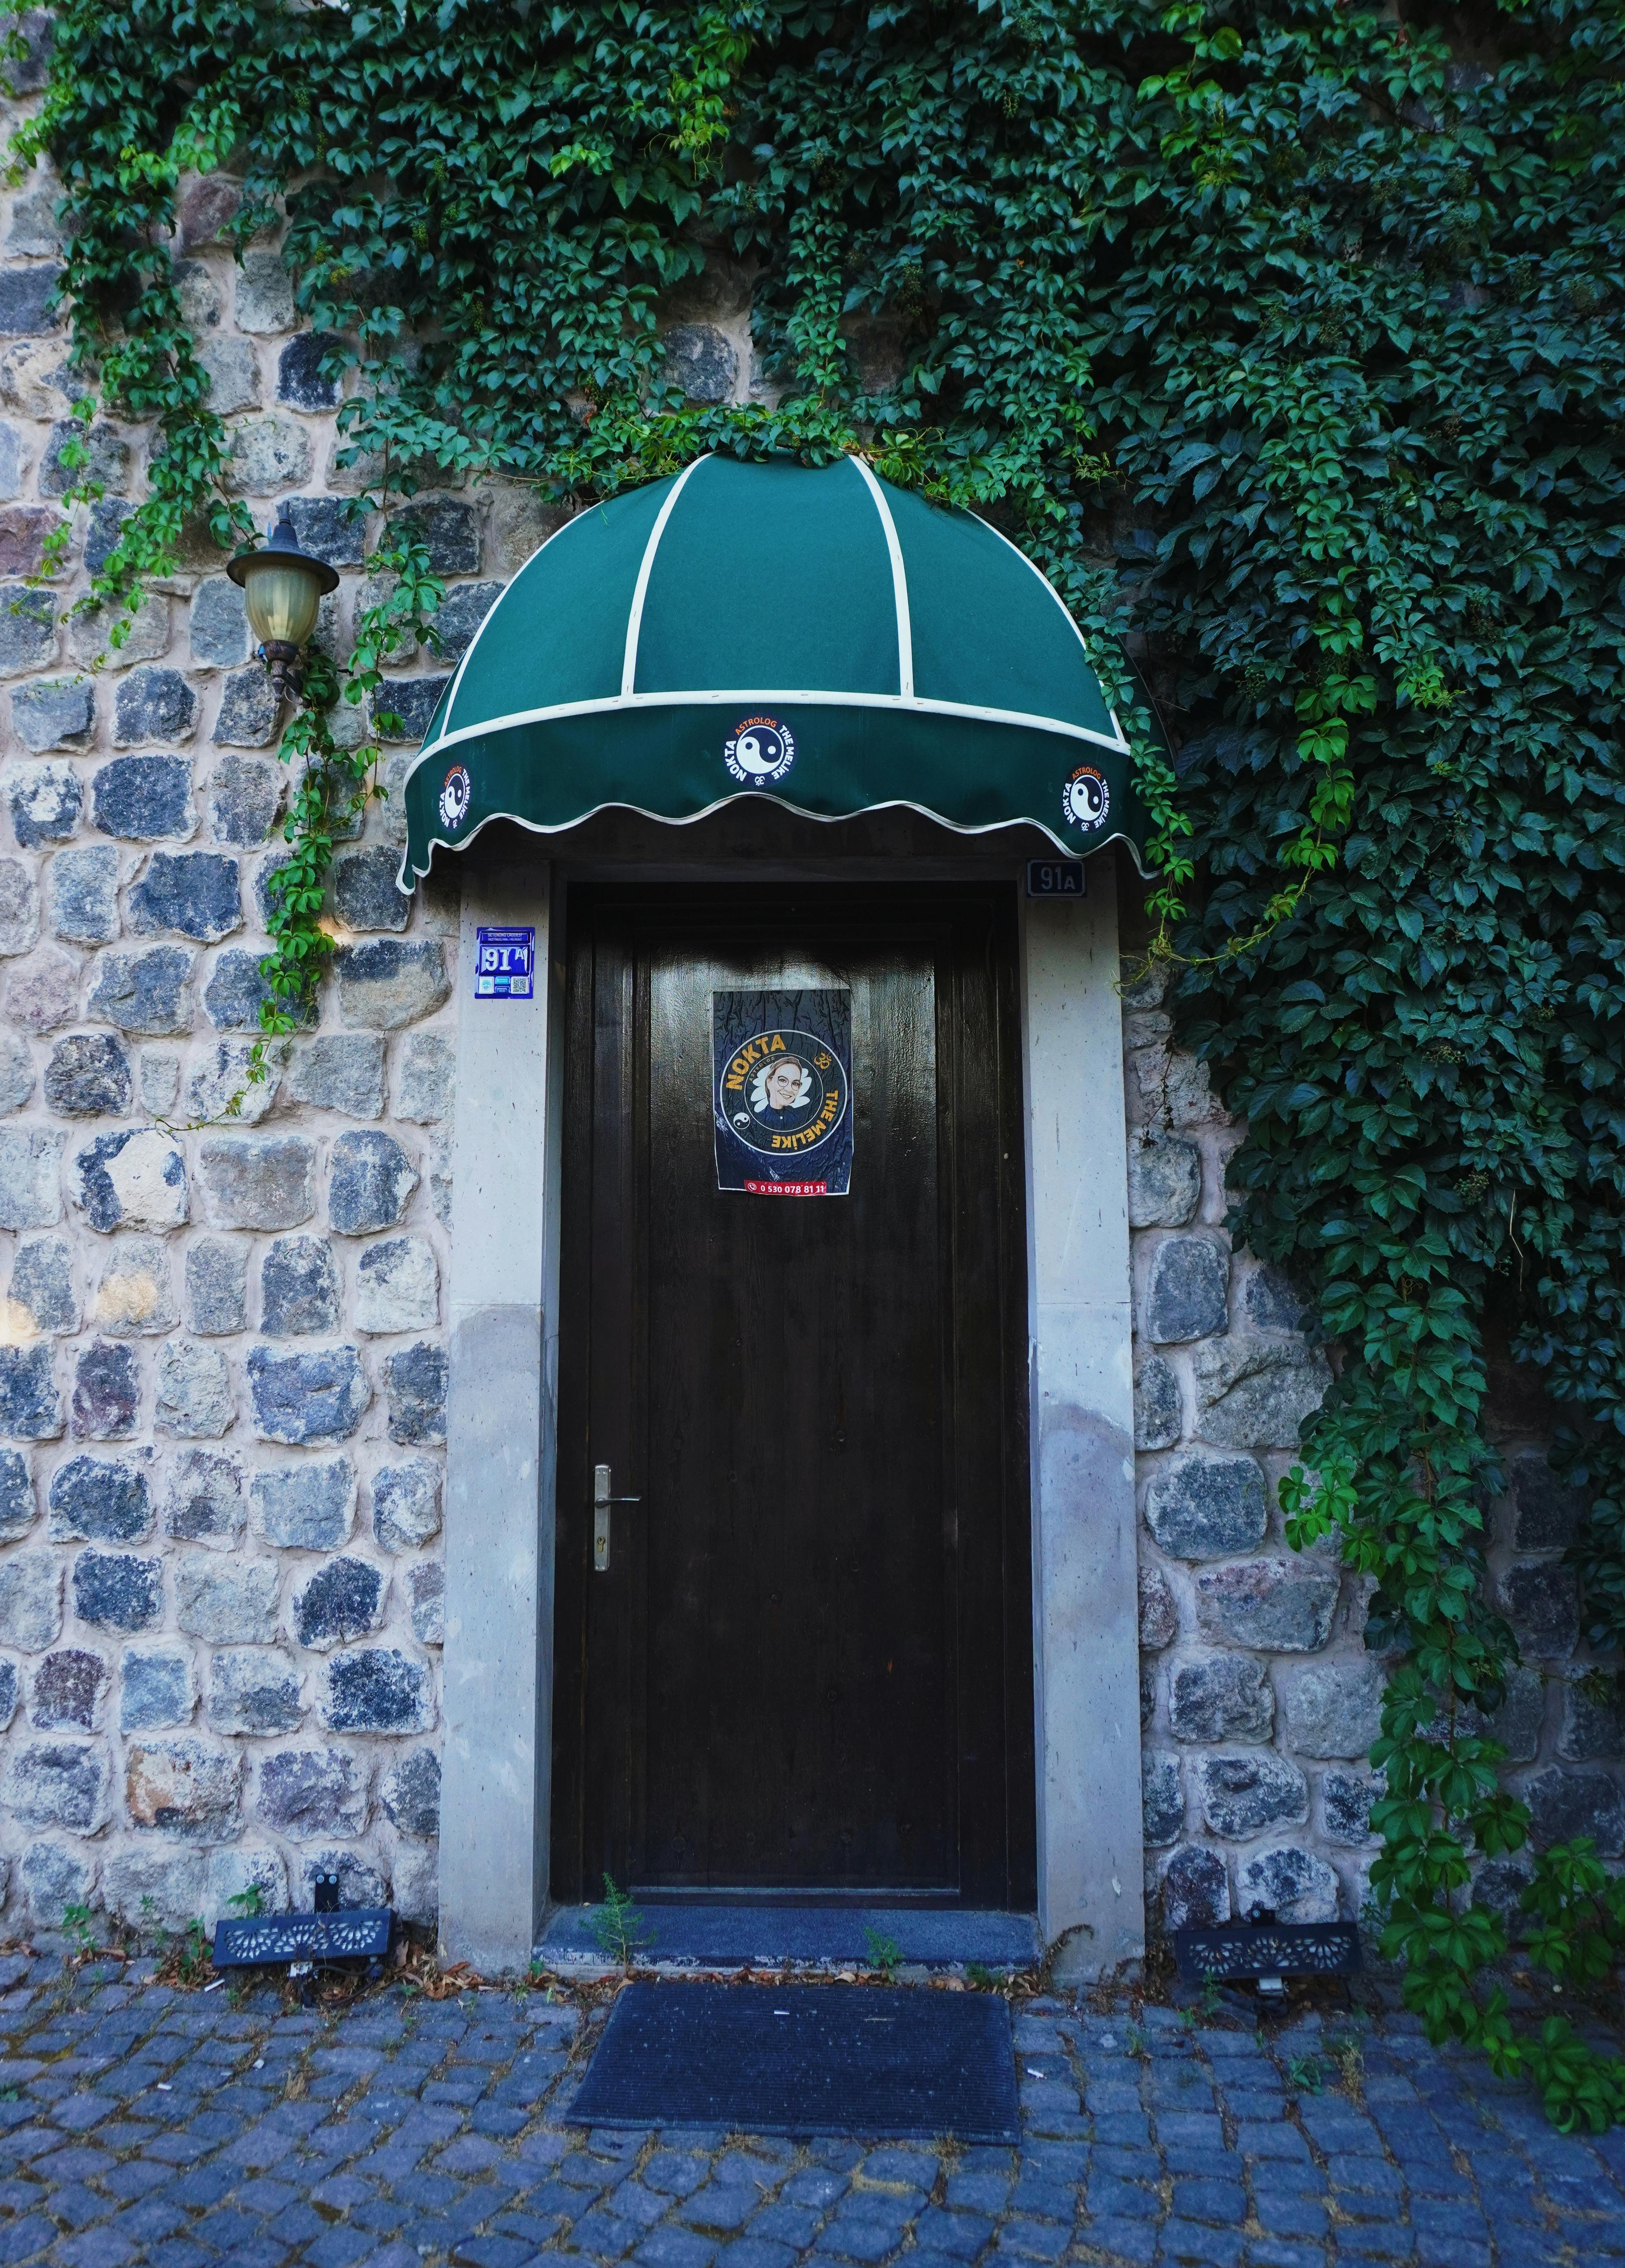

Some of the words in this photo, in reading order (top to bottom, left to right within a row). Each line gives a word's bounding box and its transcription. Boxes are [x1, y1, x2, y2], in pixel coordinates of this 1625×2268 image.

[735, 717, 777, 736] ASTROLOG
[779, 725, 794, 745] THE
[724, 740, 748, 782] NOKTA
[444, 766, 462, 787] ASTROLOG
[1072, 767, 1101, 780] ASTROLOG
[1101, 779, 1109, 798] THE
[439, 792, 450, 827] NOKTA
[1063, 783, 1076, 824] NOKTA
[1041, 866, 1076, 889] 91A
[726, 1034, 786, 1090] NOKTA
[749, 1056, 775, 1082] ASTROLOG
[821, 1090, 838, 1122] THE
[804, 1185, 813, 1193] 81
